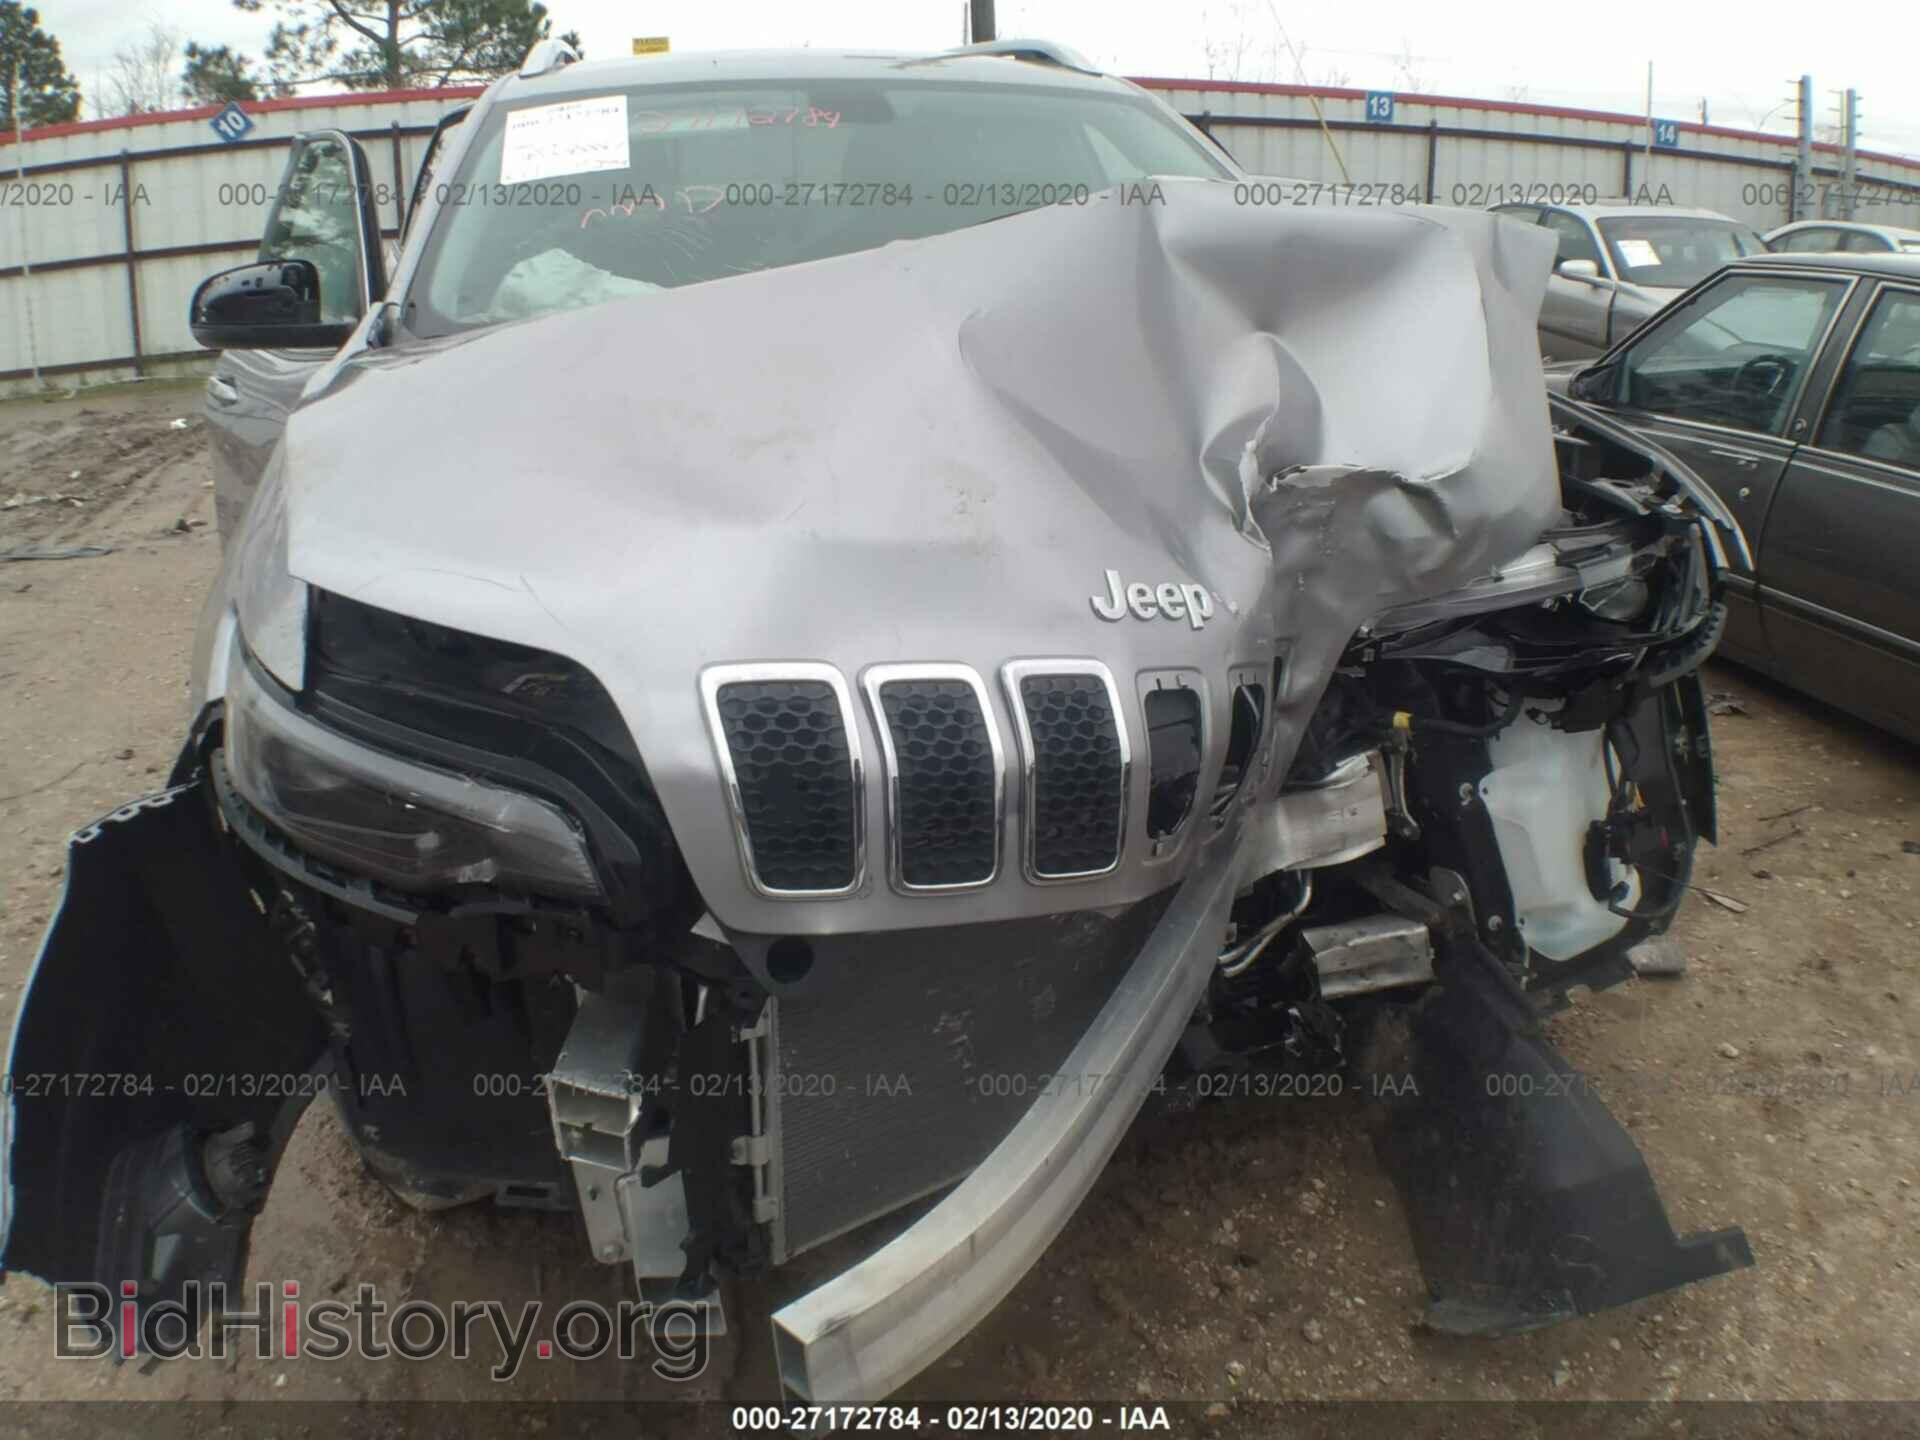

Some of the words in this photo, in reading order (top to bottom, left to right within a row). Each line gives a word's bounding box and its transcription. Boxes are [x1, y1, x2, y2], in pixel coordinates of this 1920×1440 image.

[1370, 96, 1390, 116] 13
[219, 111, 245, 138] 10
[1659, 124, 1676, 143] 14
[1089, 568, 1214, 631] Jeep
